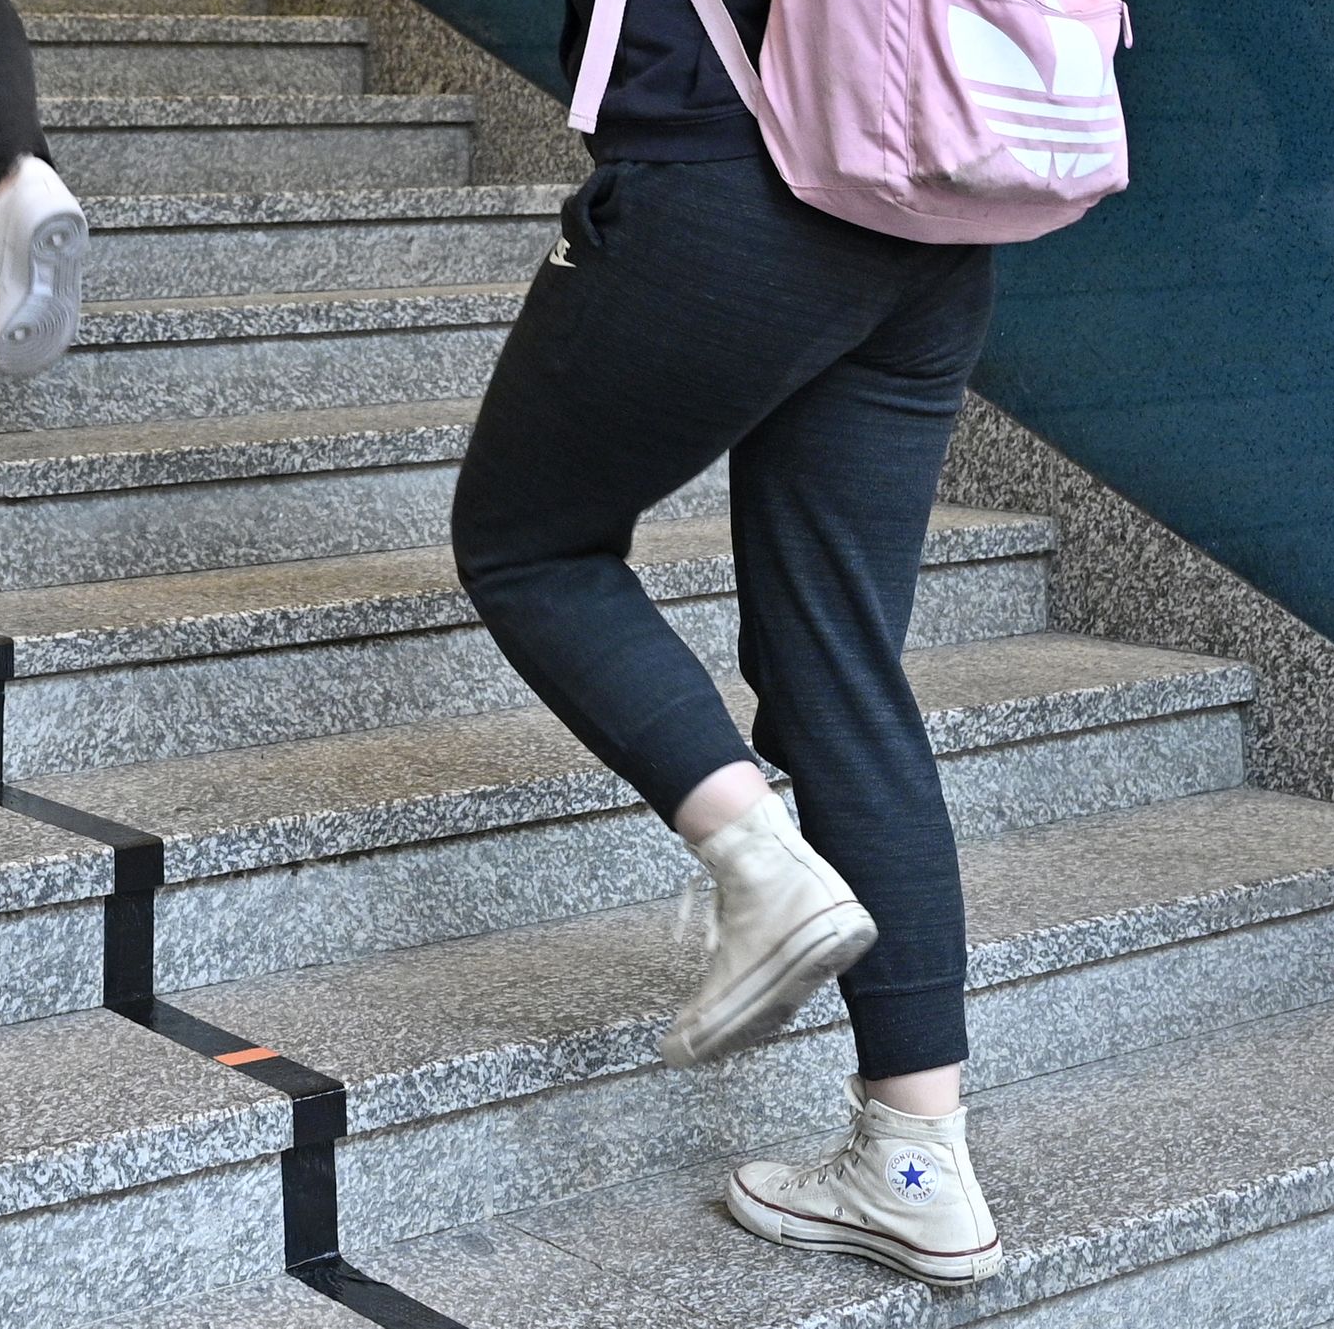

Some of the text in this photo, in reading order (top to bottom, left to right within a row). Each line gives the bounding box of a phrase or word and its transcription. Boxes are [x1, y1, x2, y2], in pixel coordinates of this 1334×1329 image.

[890, 1151, 932, 1170] CONVERSE
[896, 1186, 933, 1201] ALL STAR
